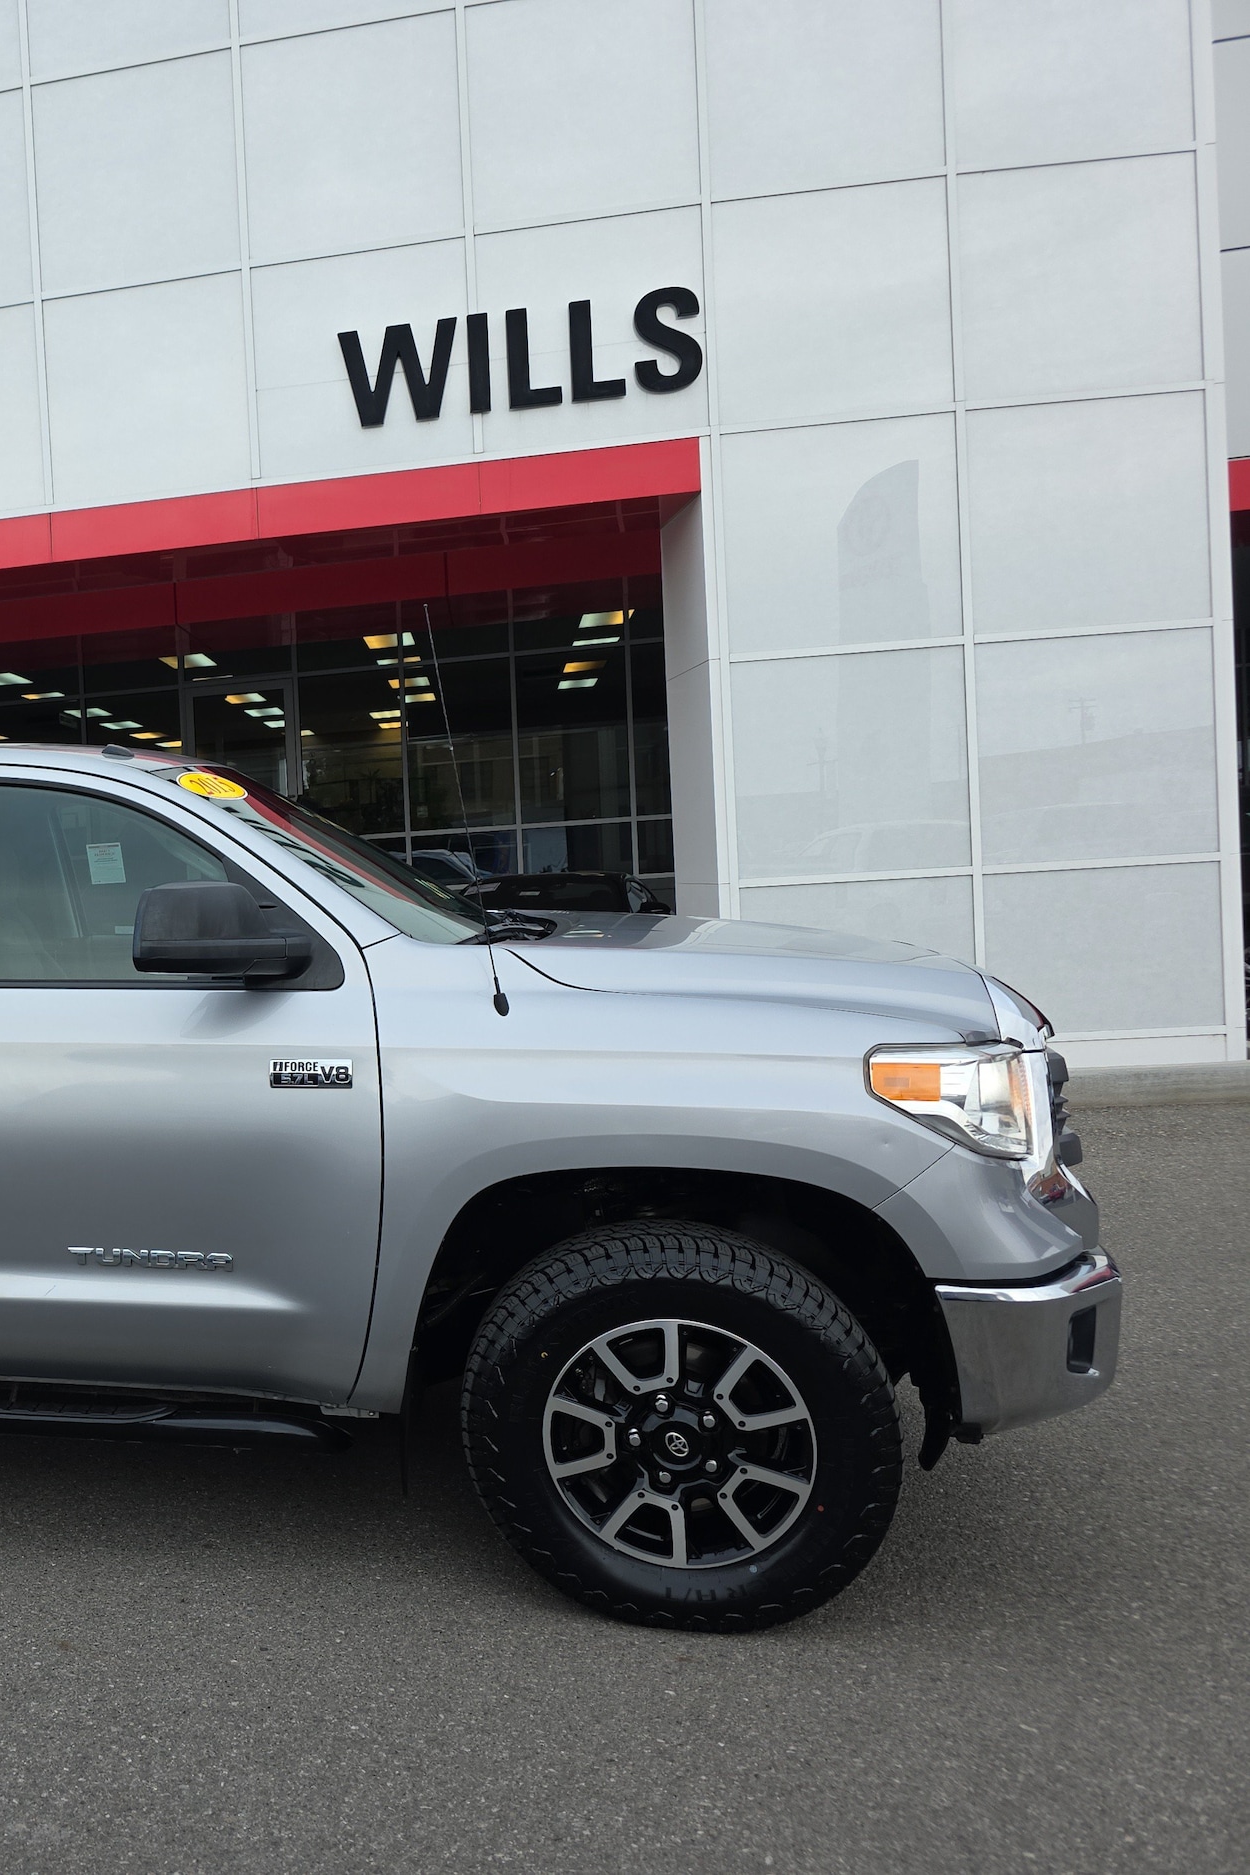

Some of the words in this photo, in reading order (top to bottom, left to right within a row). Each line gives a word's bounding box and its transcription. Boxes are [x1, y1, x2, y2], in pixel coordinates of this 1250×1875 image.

[337, 286, 703, 428] WILLS
[189, 776, 236, 796] 2015
[280, 1073, 314, 1084] 5.7L
[320, 1065, 350, 1084] V8
[67, 1246, 234, 1272] TUNDRA
